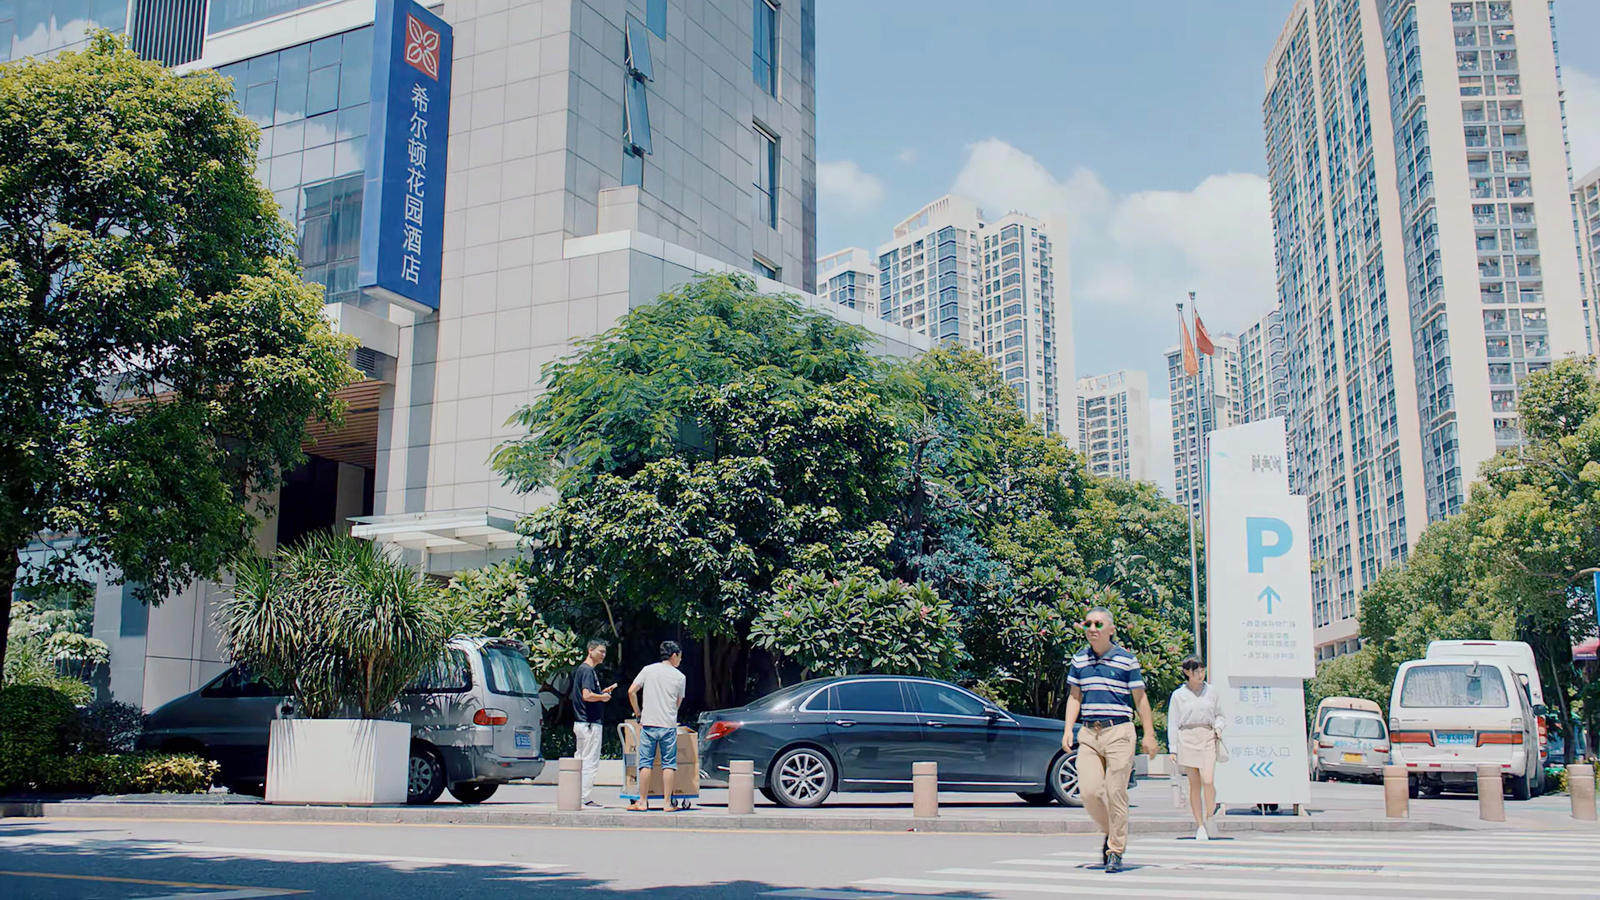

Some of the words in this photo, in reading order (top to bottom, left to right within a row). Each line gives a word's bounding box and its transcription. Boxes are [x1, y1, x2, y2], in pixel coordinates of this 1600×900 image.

[401, 82, 430, 286] 希尔顿花园酒店
[1246, 517, 1293, 573] P
[1231, 746, 1290, 758] 停车场入口
